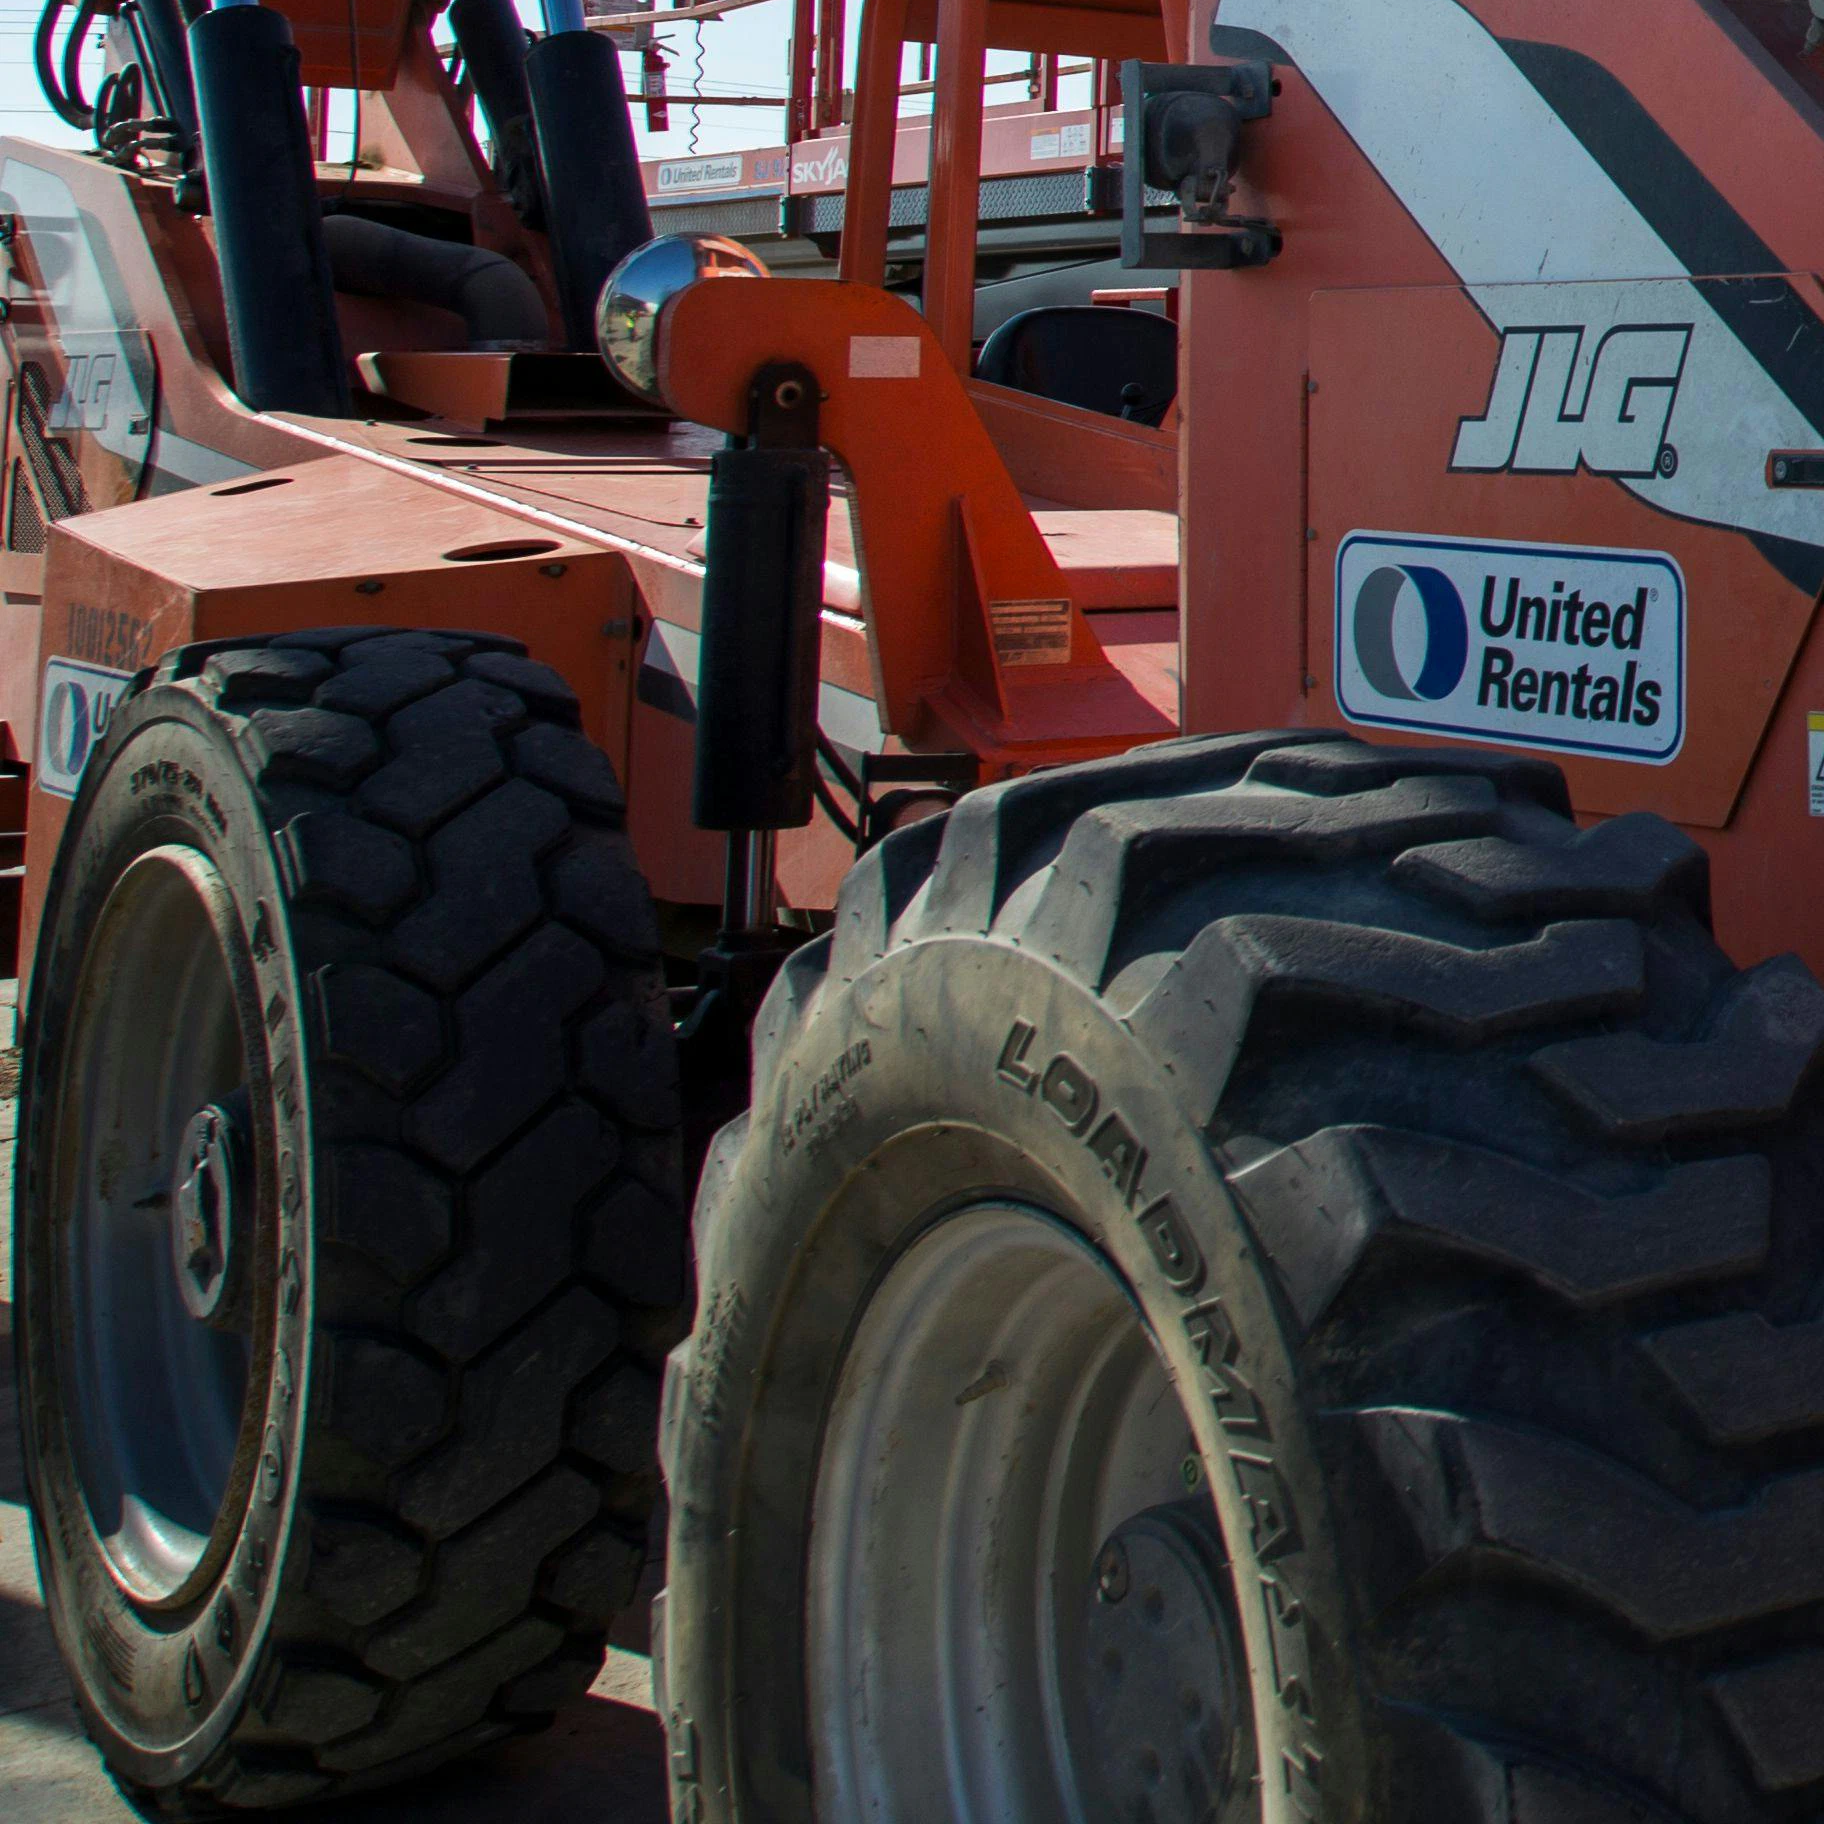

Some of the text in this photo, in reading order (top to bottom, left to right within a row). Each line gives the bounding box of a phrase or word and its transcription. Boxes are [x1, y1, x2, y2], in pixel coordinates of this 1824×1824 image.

[673, 160, 738, 185] United Rentals
[48, 353, 117, 432] JLG
[1447, 323, 1696, 479] JLG
[1480, 574, 1649, 650] United
[1477, 646, 1662, 727] Rentals
